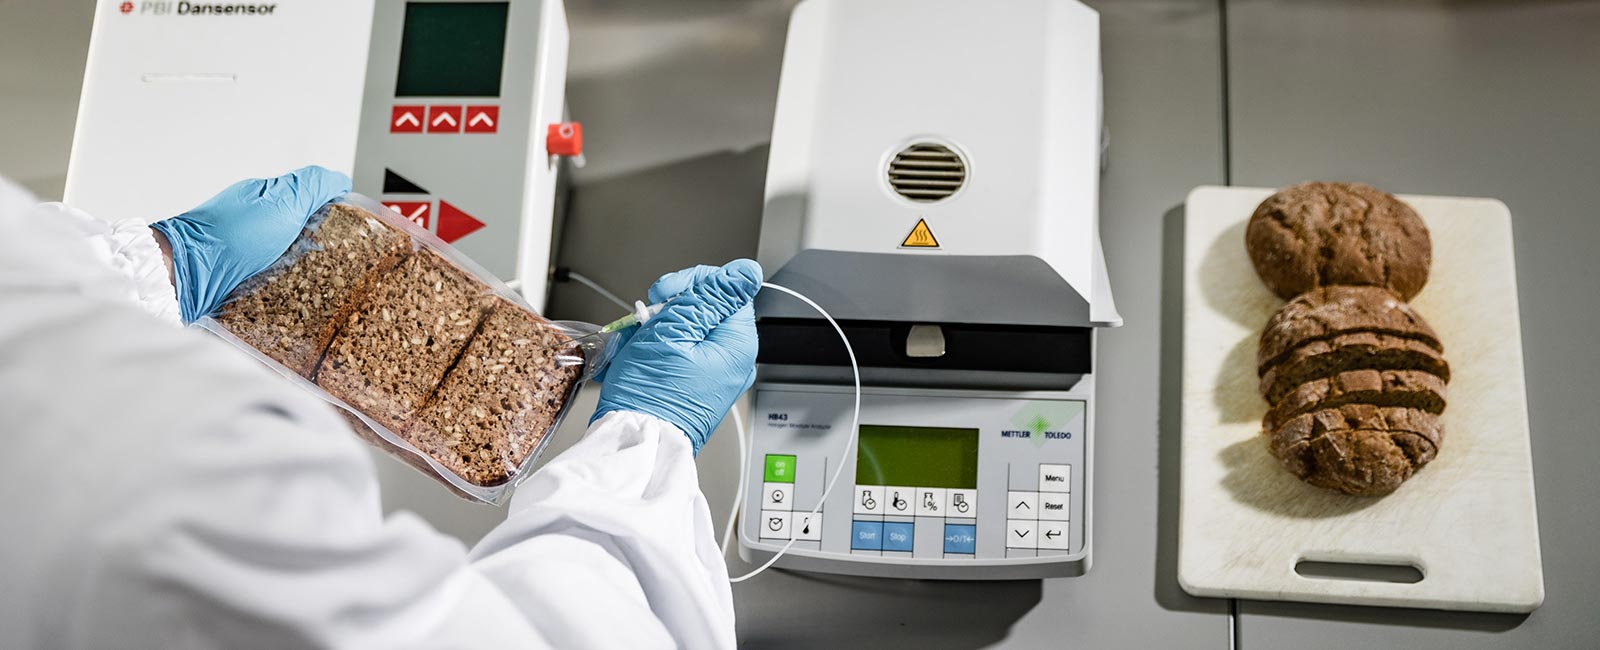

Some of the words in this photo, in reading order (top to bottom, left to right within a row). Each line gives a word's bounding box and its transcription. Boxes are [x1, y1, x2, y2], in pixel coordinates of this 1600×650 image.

[140, 1, 173, 15] PBI
[177, 1, 276, 15] Dansensor
[1001, 430, 1031, 438] METTLER
[1044, 431, 1072, 439] TOLEDO
[1045, 474, 1065, 482] Menu
[1044, 502, 1064, 510] Reset
[859, 531, 876, 540] Start
[890, 532, 907, 542] Stop
